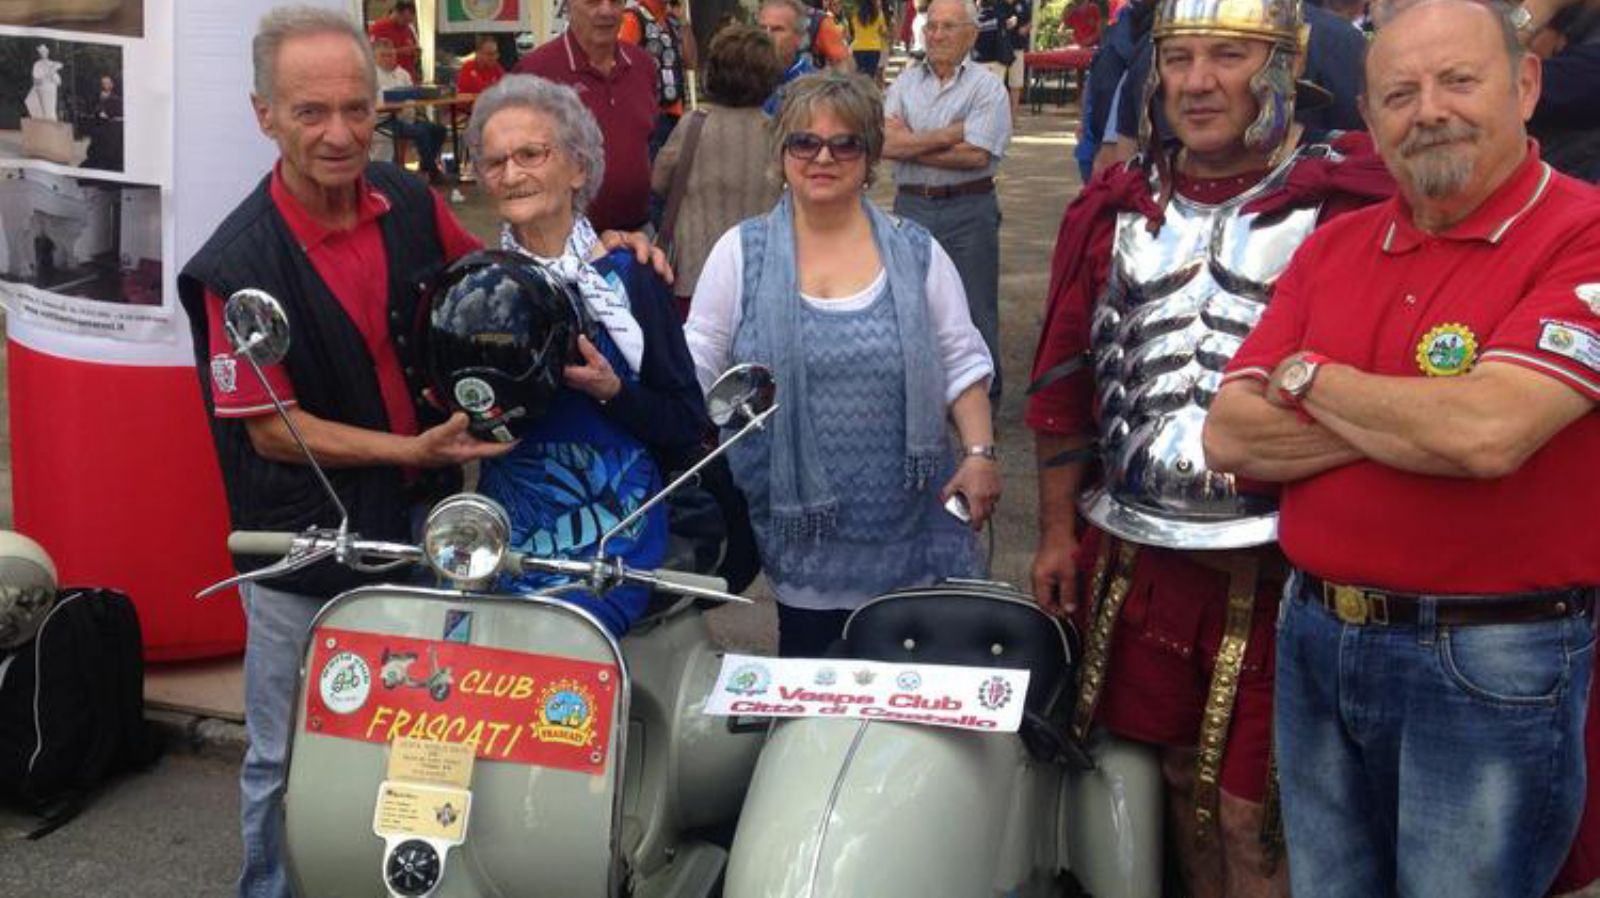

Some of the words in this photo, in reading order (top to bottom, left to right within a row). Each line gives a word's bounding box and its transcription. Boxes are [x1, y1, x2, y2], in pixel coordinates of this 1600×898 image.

[459, 669, 535, 700] CLUB
[778, 685, 876, 705] Vespa
[888, 693, 963, 711] Club
[818, 705, 848, 715] di
[859, 706, 998, 728] Castello
[365, 706, 523, 757] FRASCATI
